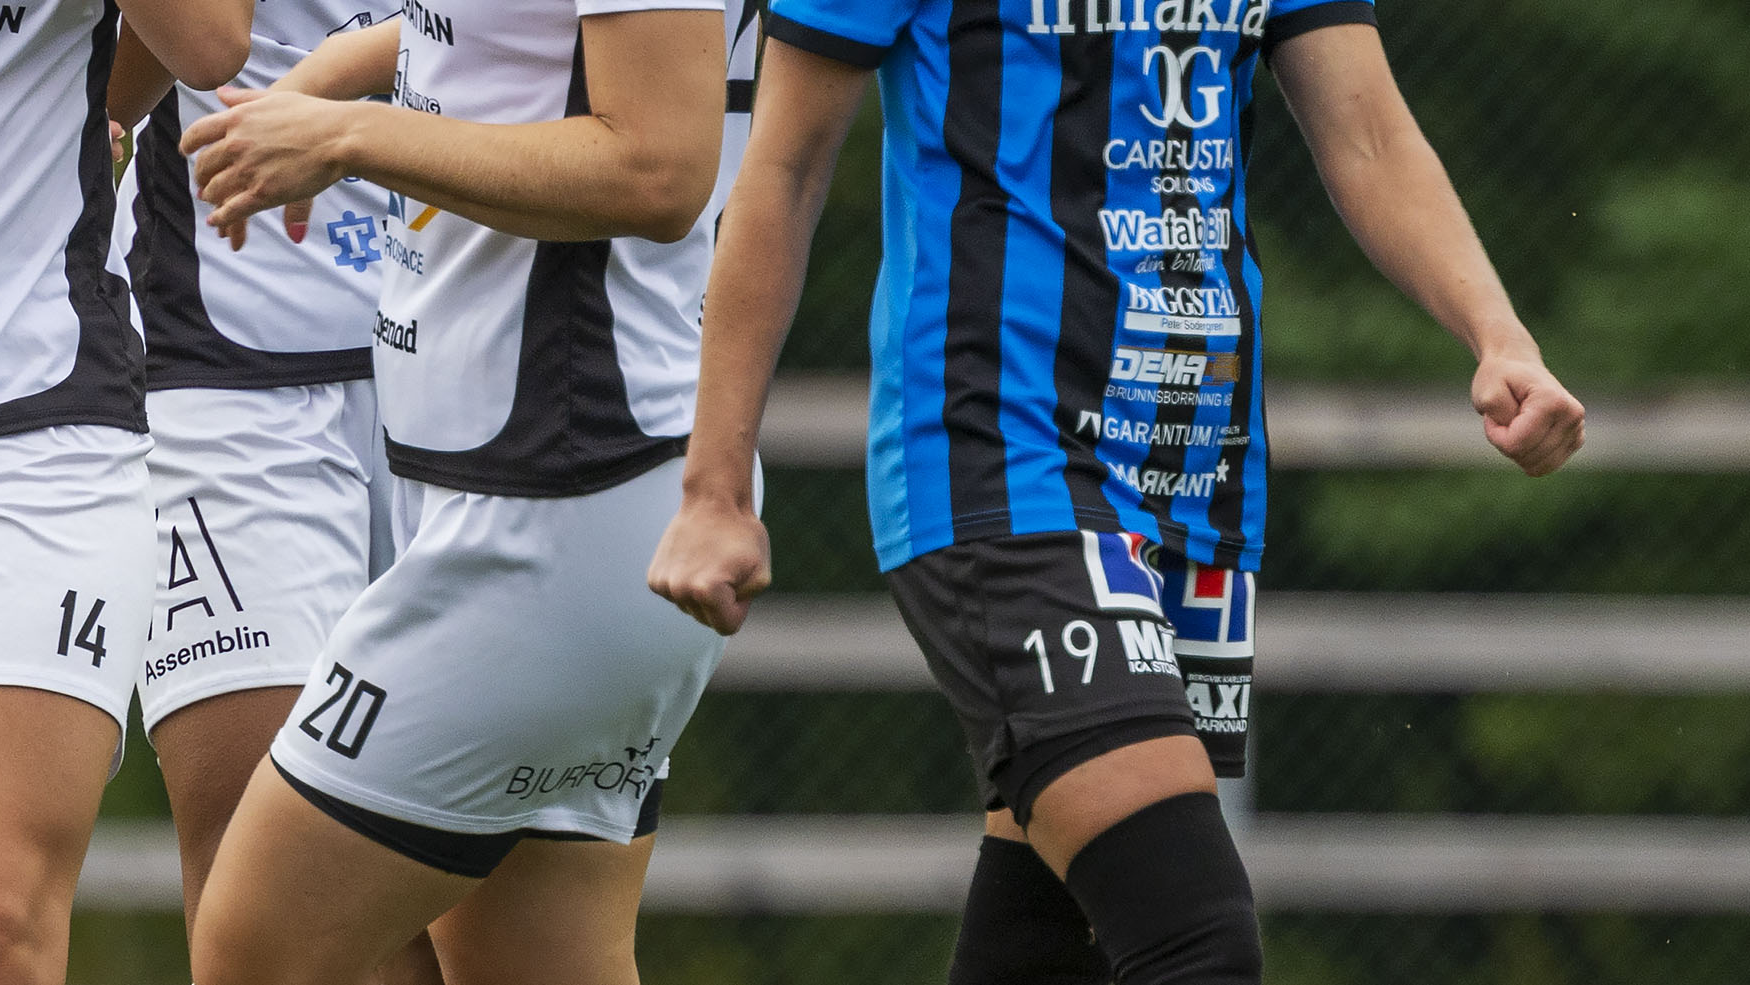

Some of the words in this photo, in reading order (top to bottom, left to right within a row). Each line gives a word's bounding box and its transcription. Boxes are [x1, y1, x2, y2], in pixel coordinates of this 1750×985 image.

[1111, 348, 1208, 386] DEMA
[1103, 416, 1214, 447] GARANTUM
[56, 589, 107, 668] 14
[146, 626, 270, 686] Assemblin
[1022, 619, 1099, 695] 19
[298, 661, 388, 760] 20
[1185, 682, 1251, 718] AXI
